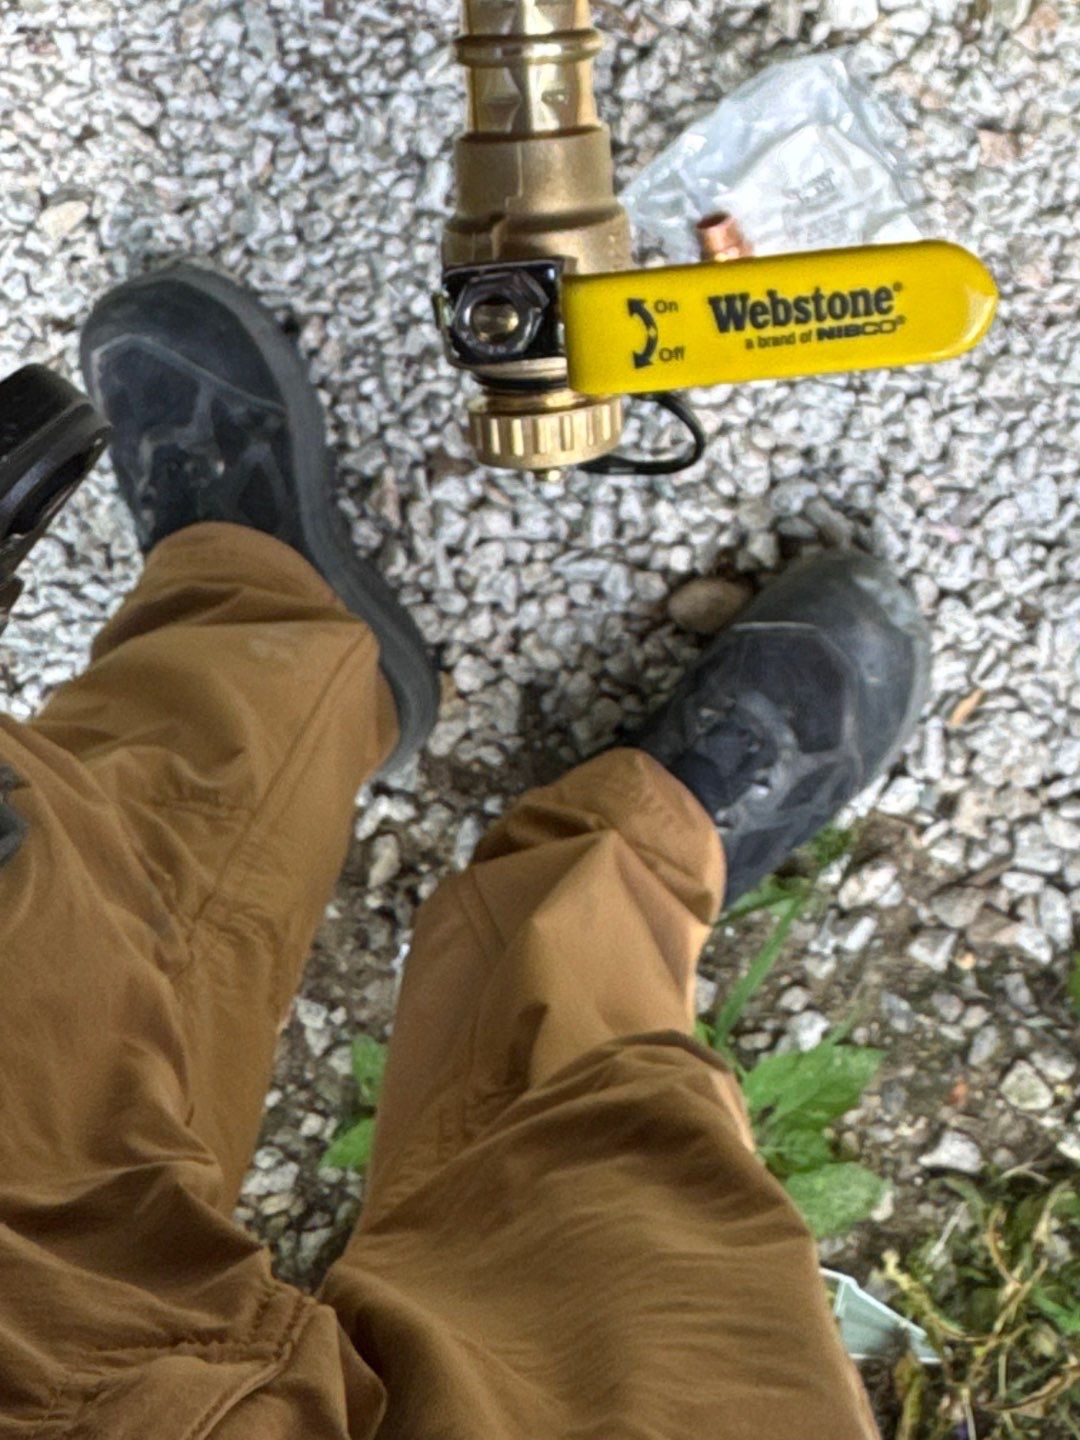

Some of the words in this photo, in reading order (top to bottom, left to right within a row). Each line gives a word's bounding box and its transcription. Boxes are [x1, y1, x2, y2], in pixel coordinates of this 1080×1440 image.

[653, 299, 679, 314] On
[745, 337, 755, 350] a
[757, 332, 796, 349] brand
[799, 329, 813, 344] of
[658, 345, 687, 363] Off
